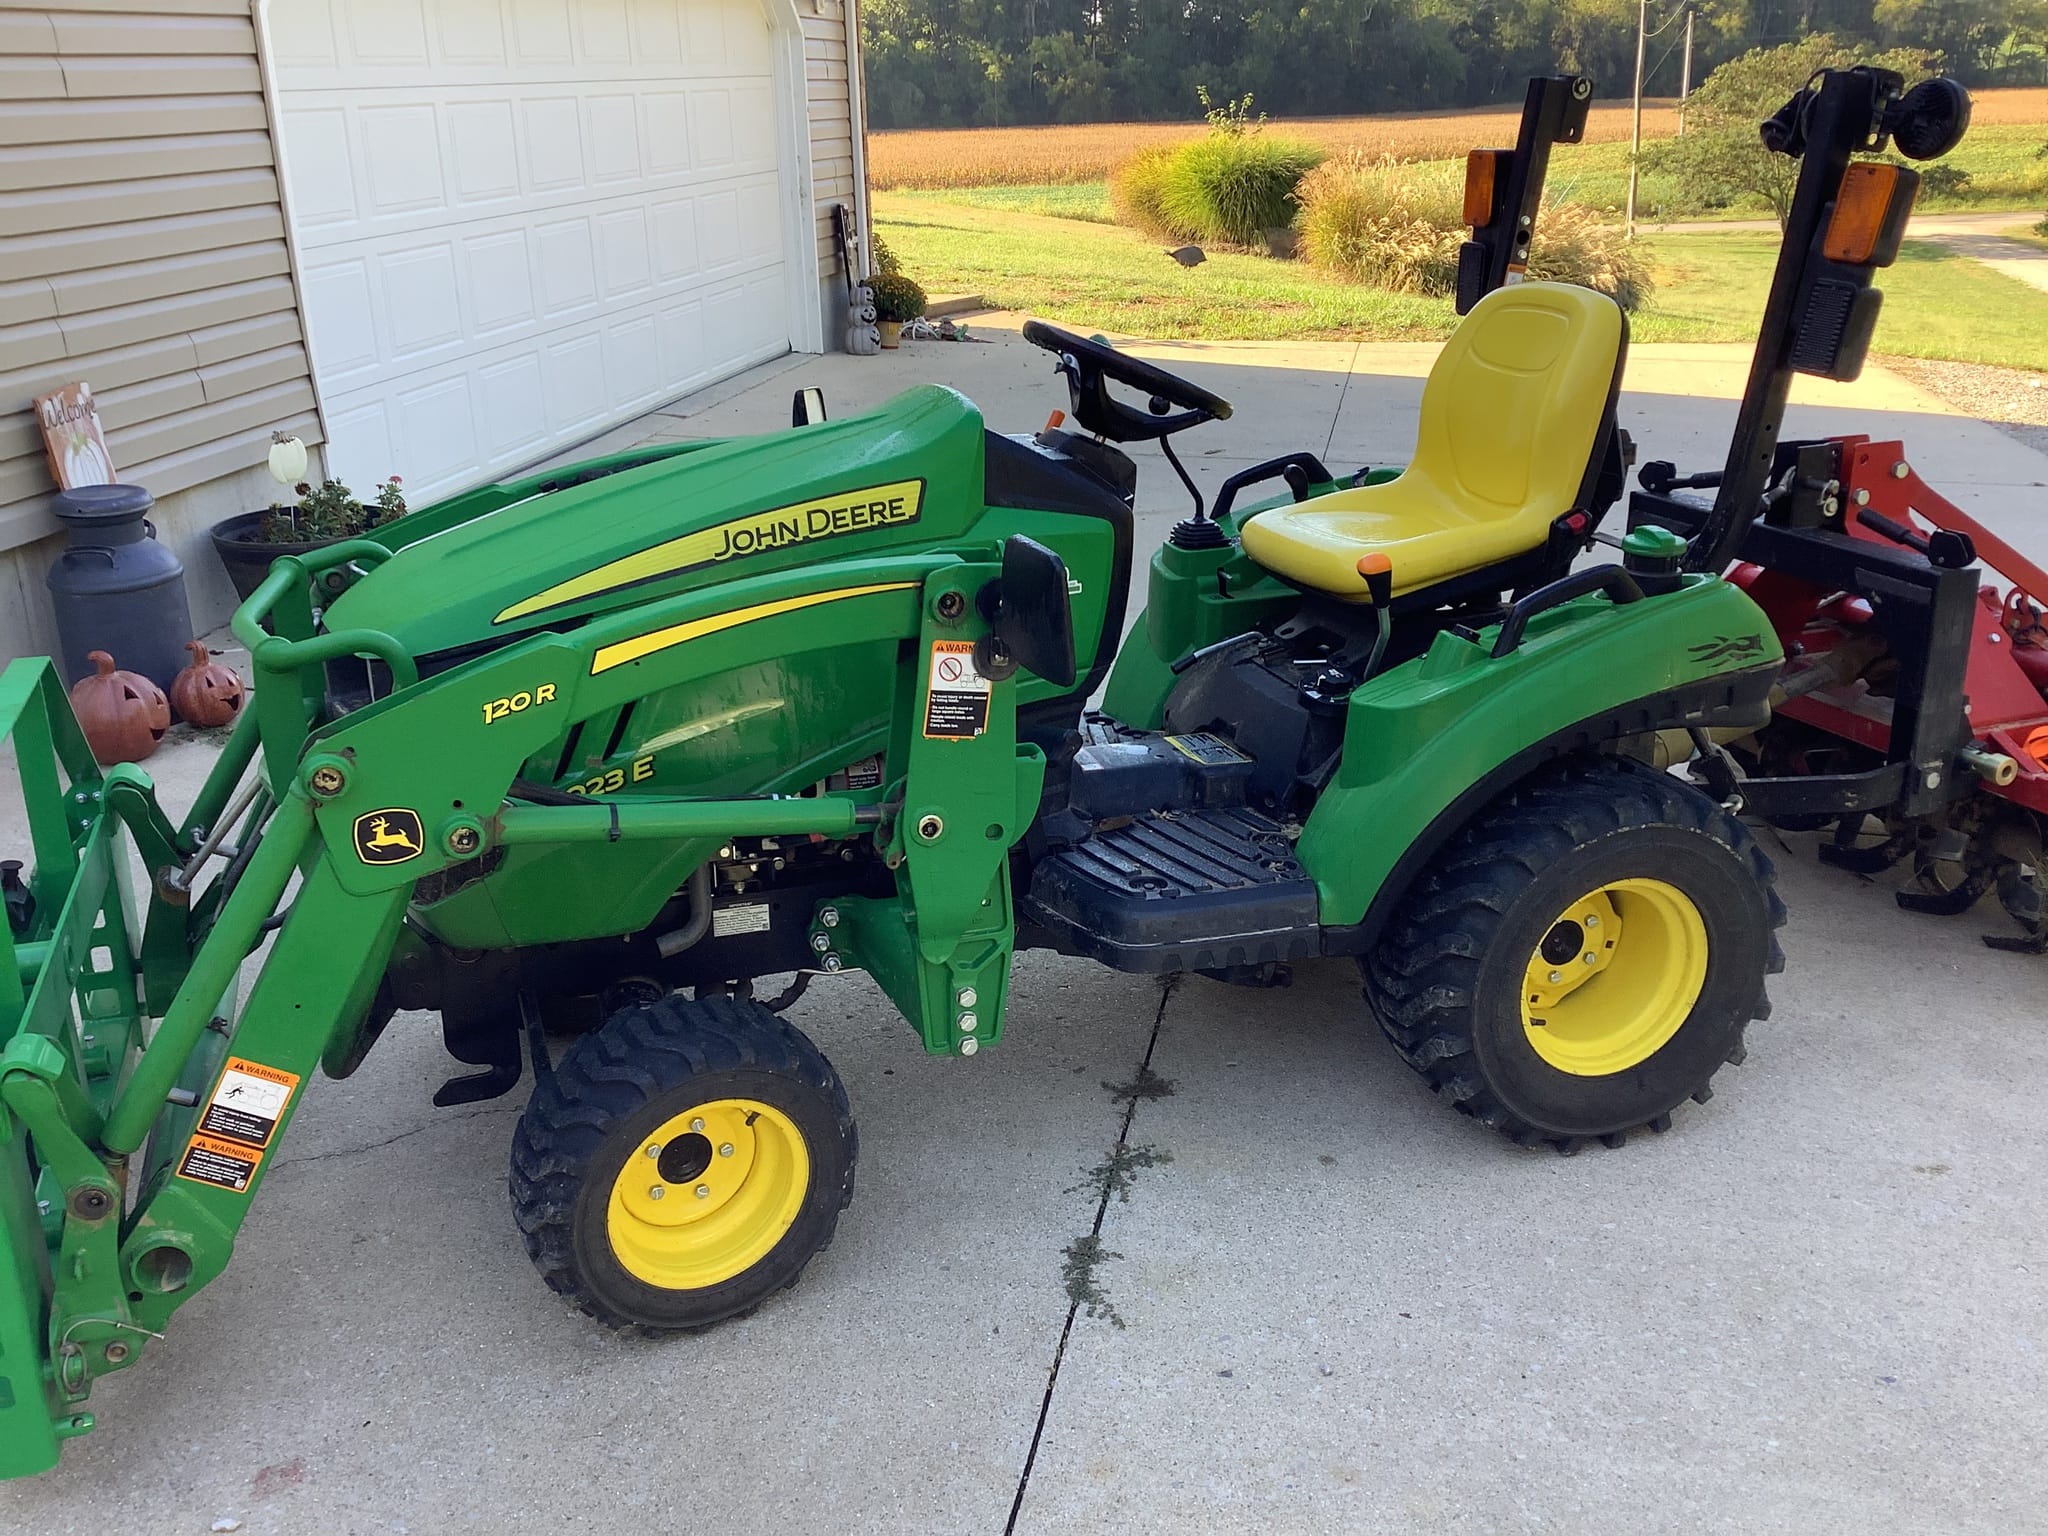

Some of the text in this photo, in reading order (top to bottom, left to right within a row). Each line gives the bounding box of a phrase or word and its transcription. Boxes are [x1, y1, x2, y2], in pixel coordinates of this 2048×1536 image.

[43, 398, 97, 430] Welcome
[714, 497, 906, 558] JOHN DEERE
[945, 643, 975, 653] WARN
[482, 682, 557, 725] 120 R
[632, 755, 655, 783] E
[246, 1065, 290, 1083] WARNING
[211, 1143, 254, 1160] WARNING
